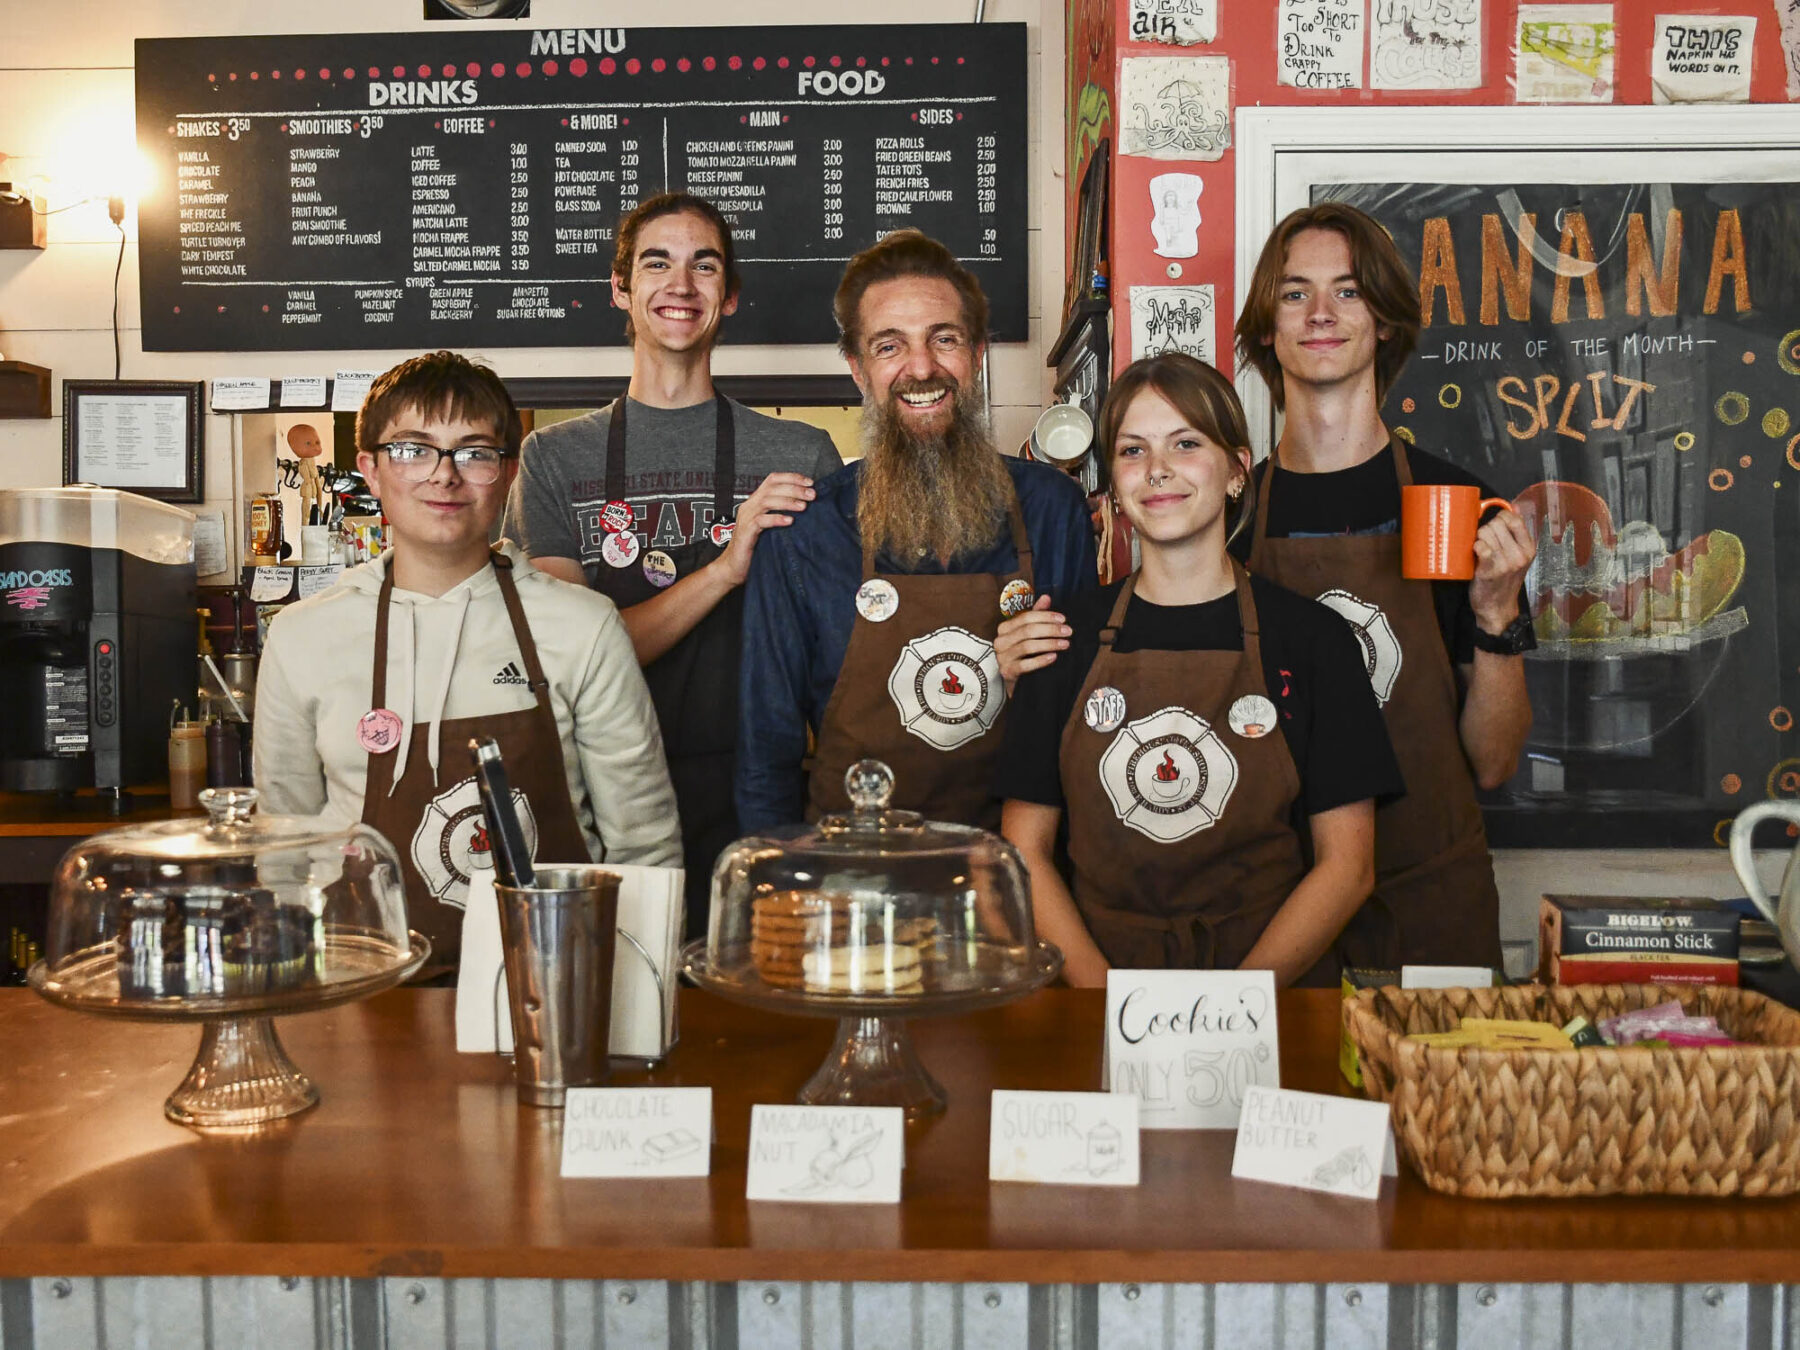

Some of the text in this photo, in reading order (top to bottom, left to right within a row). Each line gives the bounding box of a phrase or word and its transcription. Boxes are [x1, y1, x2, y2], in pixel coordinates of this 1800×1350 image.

[530, 28, 626, 56] MENU
[1666, 26, 1742, 51] THIS
[1669, 63, 1709, 73] WORDS
[798, 70, 886, 96] FOOD
[369, 79, 478, 106] DRINKS
[750, 111, 781, 127] MAIN
[919, 109, 954, 125] SIDES
[176, 121, 220, 137] SHAKES
[289, 119, 352, 136] SMOOTHIES
[443, 117, 485, 134] COFFEE
[586, 142, 606, 153] SODA
[686, 141, 719, 153] CHICKEN
[720, 141, 736, 153] AND
[768, 139, 794, 151] PANINI
[876, 138, 924, 150] PIZZA ROLLS
[178, 152, 210, 162] VANILLA
[290, 148, 340, 160] STRAWBERRY
[411, 146, 435, 157] LATTE
[876, 151, 952, 162] FRIED GREEN BEANS
[411, 160, 440, 171] COFFEE
[555, 157, 570, 168] TEA
[688, 156, 718, 167] TOMATO
[770, 153, 797, 166] PANINI
[290, 162, 317, 173] MANGO
[876, 164, 922, 176] TATER TOTS
[429, 175, 457, 186] COFFEE
[555, 171, 615, 182] HOT CHOCOLATE
[687, 171, 743, 182] CHEESE PANINI
[291, 177, 316, 188] PEACH
[876, 178, 930, 188] FRENCH FRIES
[412, 189, 450, 200] ESPRESSO
[555, 186, 597, 196] POWERADE
[687, 186, 766, 197] CHICKEN QUESADILLA
[876, 191, 952, 202] FRIED CAULIFLOWER
[179, 194, 229, 204] STRAWBERRY
[292, 191, 322, 203] BANANA
[412, 204, 456, 215] AMERICANO
[555, 200, 601, 212] GLASS SODA
[718, 200, 764, 211] QUESADILLA
[876, 204, 912, 214] BROWNIE
[195, 208, 226, 219] FRECKLE
[292, 206, 338, 218] FRUIT PUNCH
[206, 222, 230, 233] PEACH
[310, 220, 347, 231] SMOOTHIE
[412, 218, 468, 229] MATCHA LATTE
[440, 232, 469, 244] FRAPPE
[556, 228, 613, 240] WATER BOTTLE
[181, 237, 207, 248] TURTLE
[292, 234, 308, 246] ANY
[308, 234, 334, 246] COMBO
[444, 246, 471, 258] MOCHA
[472, 246, 501, 258] FRAPPE
[556, 244, 598, 254] SWEET TEA
[181, 250, 235, 261] DARK TEMPEST
[182, 265, 247, 276] WHITE CHOCOLATE
[414, 260, 442, 272] SALTED
[474, 260, 501, 272] MOCHA
[1419, 208, 1752, 327] ANANA
[406, 277, 435, 288] SYRUPS
[288, 290, 315, 300] VANILLA
[354, 289, 403, 299] PUMPKIN SPICE
[430, 288, 473, 298] GREEN APPLE
[286, 302, 316, 311] CARAMEL
[362, 300, 396, 310] HAZELNUT
[432, 299, 471, 310] RASPBERRY
[512, 298, 550, 308] CHOCOLATE
[282, 314, 322, 324] PEPPERMINT
[364, 313, 394, 322] COCONUT
[430, 310, 473, 320] BLACKBERRY
[496, 308, 520, 320] SUGAR
[520, 308, 537, 320] FREE
[1525, 340, 1548, 358] OF
[1571, 337, 1608, 356] THE
[1497, 370, 1657, 443] SPLIT
[29, 569, 72, 587] OASIS
[493, 675, 527, 685] adidas
[1607, 914, 1693, 927] BIGELOW
[1585, 931, 1713, 949] Cinnamon Stick
[569, 1095, 672, 1122] CHOCOLATE
[1246, 1091, 1328, 1124] PEANUT
[1002, 1101, 1083, 1141] SUGAR
[568, 1127, 632, 1155] CHUNK
[1242, 1121, 1319, 1150] BUTTER
[754, 1140, 799, 1165] NUT
